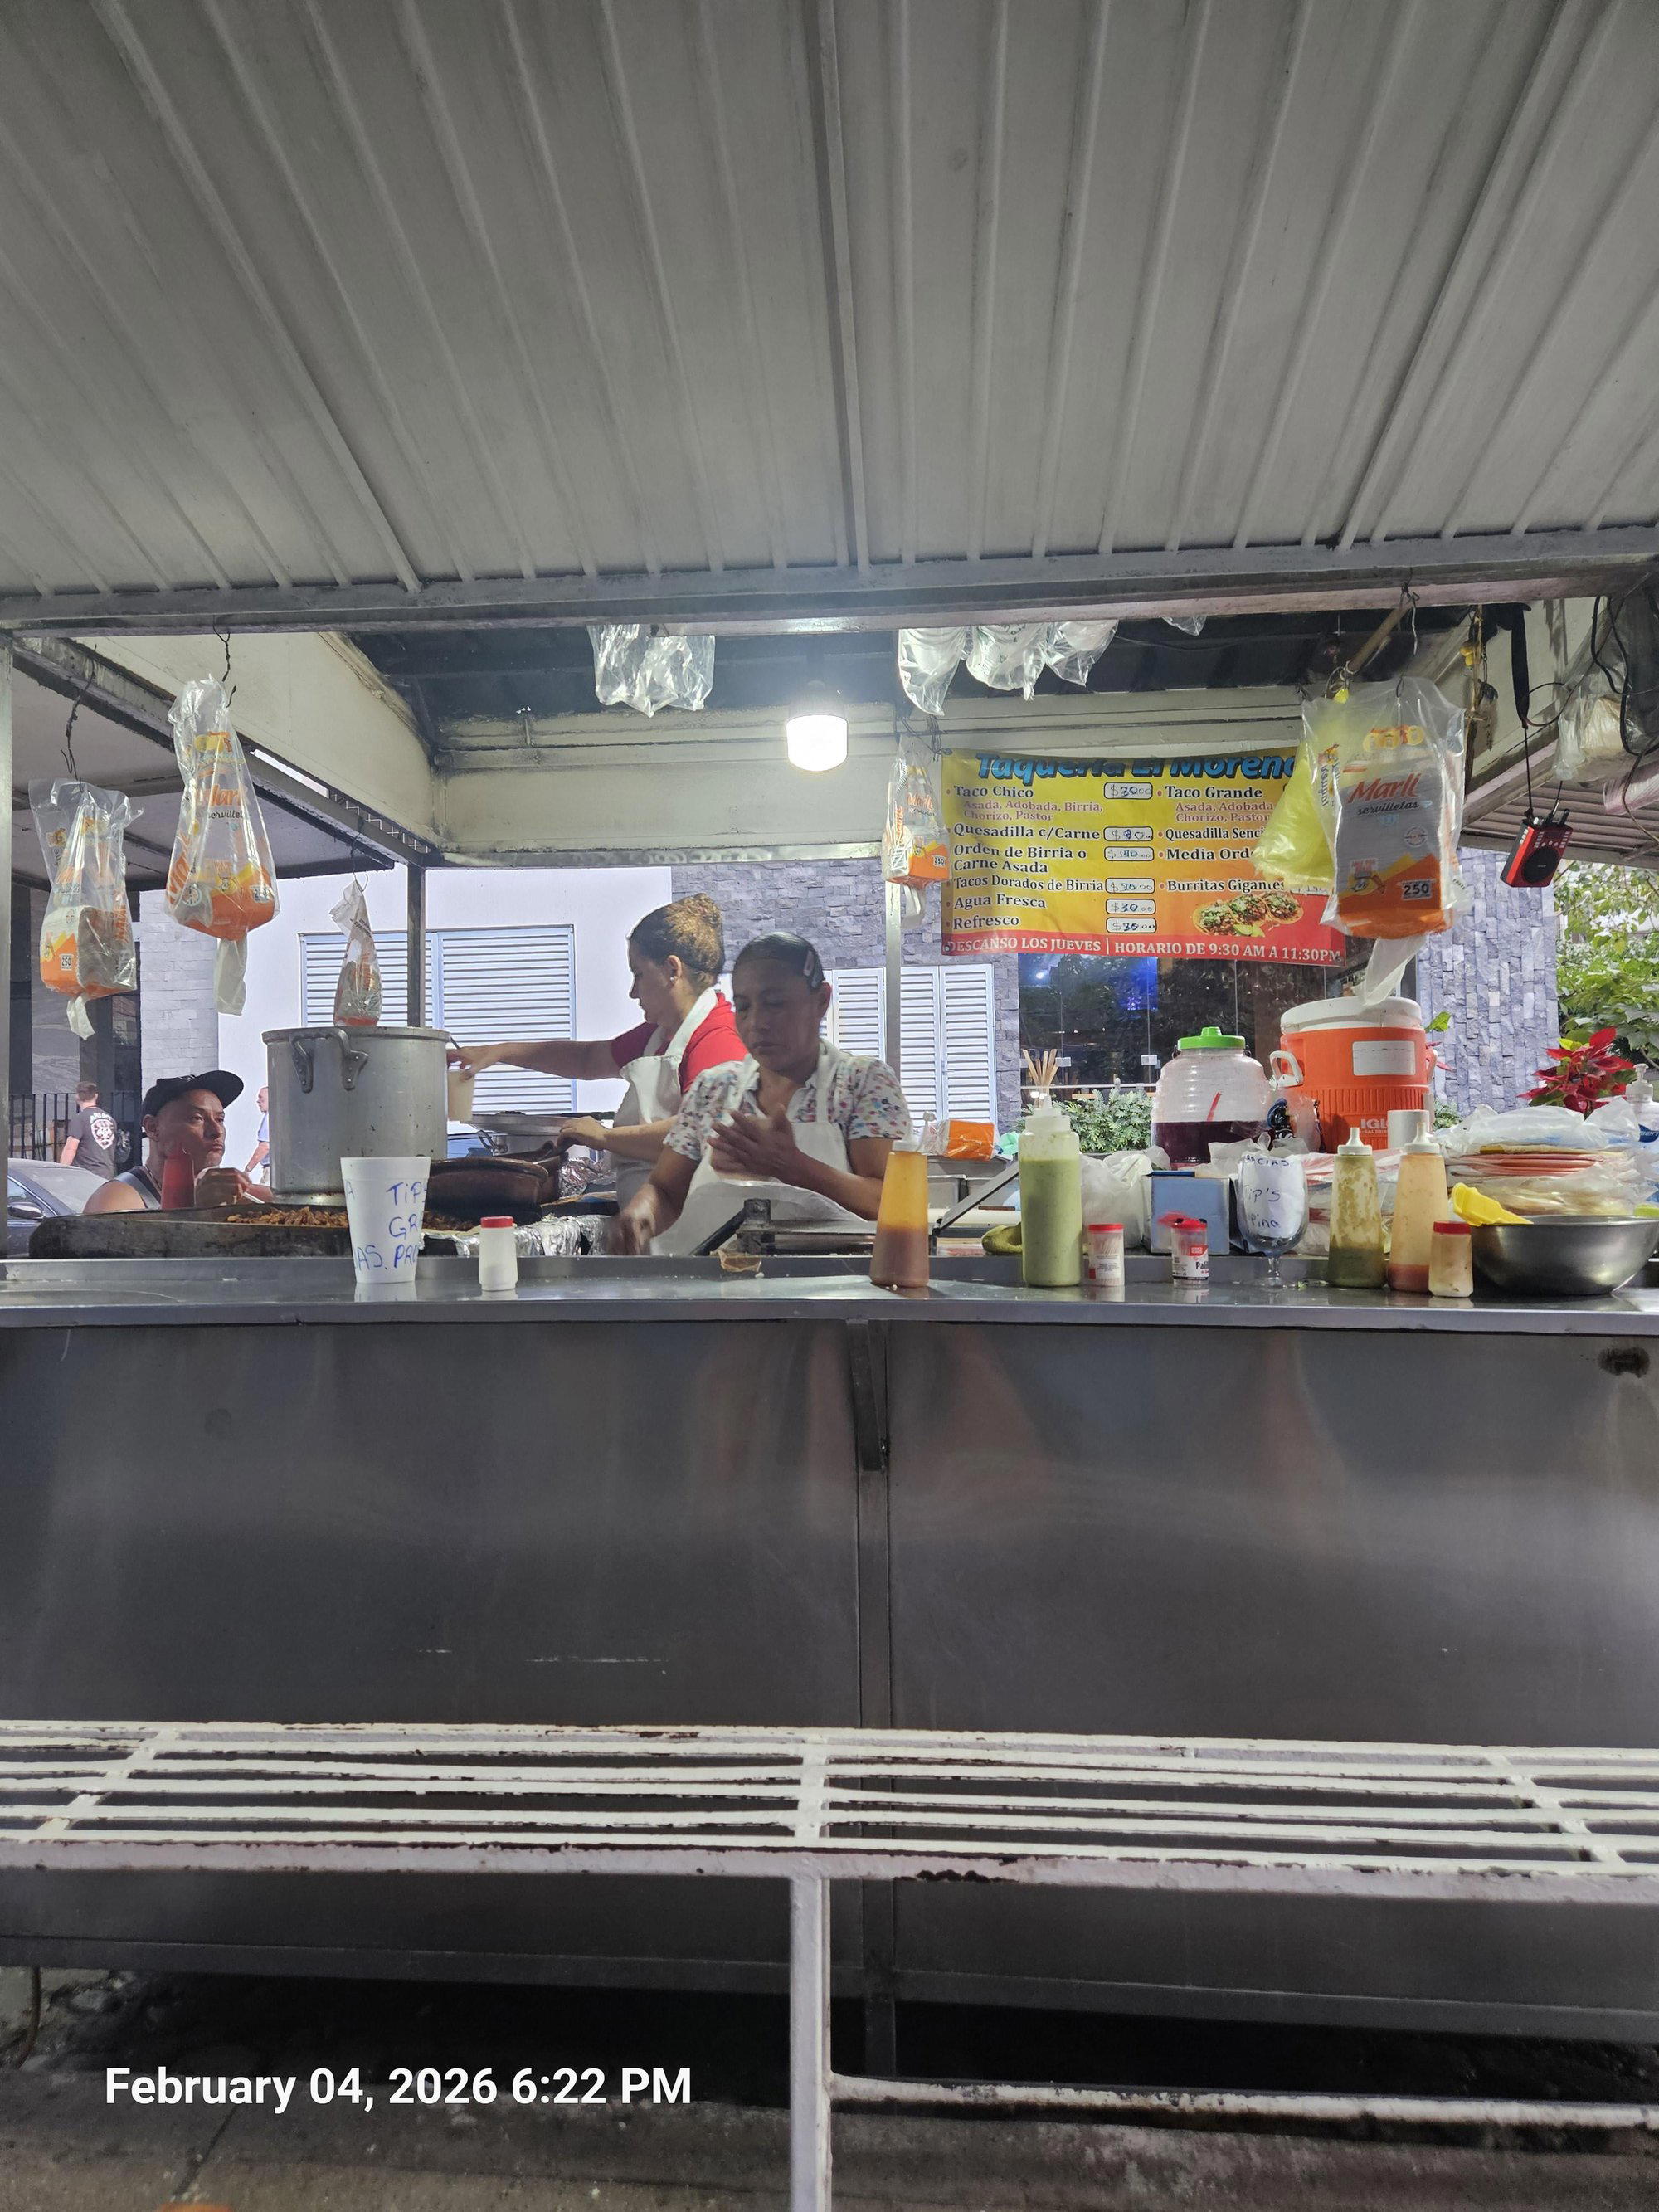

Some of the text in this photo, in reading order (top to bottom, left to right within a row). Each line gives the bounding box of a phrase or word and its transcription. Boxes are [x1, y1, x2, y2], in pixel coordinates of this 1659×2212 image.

[953, 785, 1034, 798] Taco Chico
[1165, 786, 1263, 799] Taco Grande
[1347, 772, 1422, 803] Marli
[1006, 801, 1062, 812] Adobada,
[1064, 801, 1103, 812] Birria,
[1176, 802, 1216, 812] Asada,
[964, 810, 1054, 821] Chorizo, Pastor
[1176, 813, 1228, 823] Chorizo,
[954, 823, 1101, 840] Quesadilla c/Carne
[1165, 828, 1264, 841] Quesadilla Senci
[954, 844, 1087, 859] Orden de Birria o
[1166, 848, 1254, 860] Media Ord
[954, 860, 1048, 874] Carne Asada
[954, 875, 1104, 891] Tacos Dorados de Birria
[1404, 882, 1430, 896] 250
[954, 894, 1047, 911] Agua Fresca
[953, 915, 1020, 930] Refresco
[949, 937, 1018, 953] DESCANSO
[1021, 938, 1048, 950] LOS
[1050, 938, 1102, 952] JUEVES
[1115, 942, 1182, 954] HORARIO
[1185, 943, 1206, 955] DE
[1209, 943, 1239, 956] 9:30
[1244, 947, 1265, 958] AM
[1268, 948, 1279, 958] A
[1360, 1118, 1388, 1129] IGL
